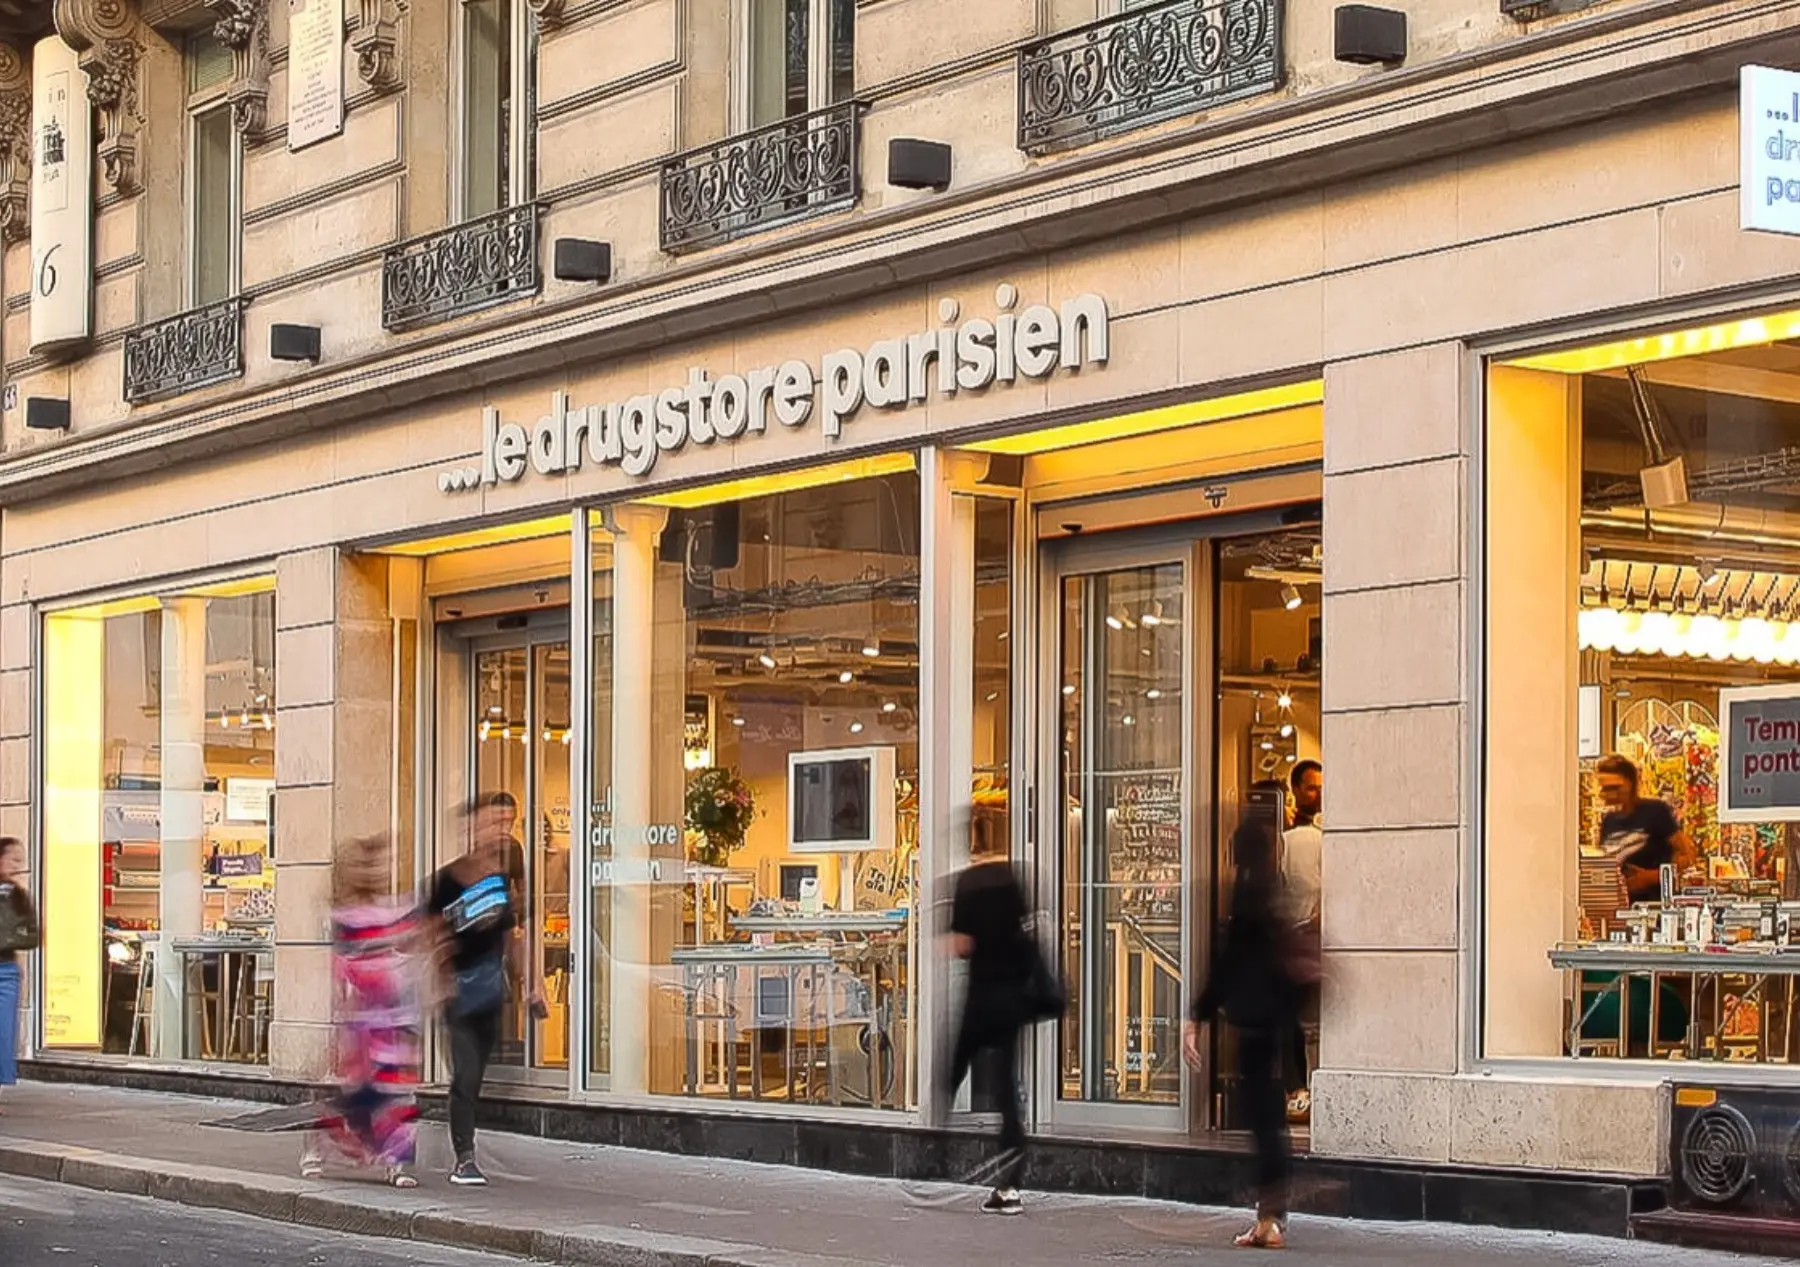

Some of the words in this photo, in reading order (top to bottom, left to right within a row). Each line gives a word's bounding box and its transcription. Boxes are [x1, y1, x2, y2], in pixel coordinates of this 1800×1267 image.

[1766, 92, 1800, 123] ...l
[1765, 129, 1800, 161] dr
[822, 283, 1108, 437] parisien
[1744, 716, 1800, 745] Tem
